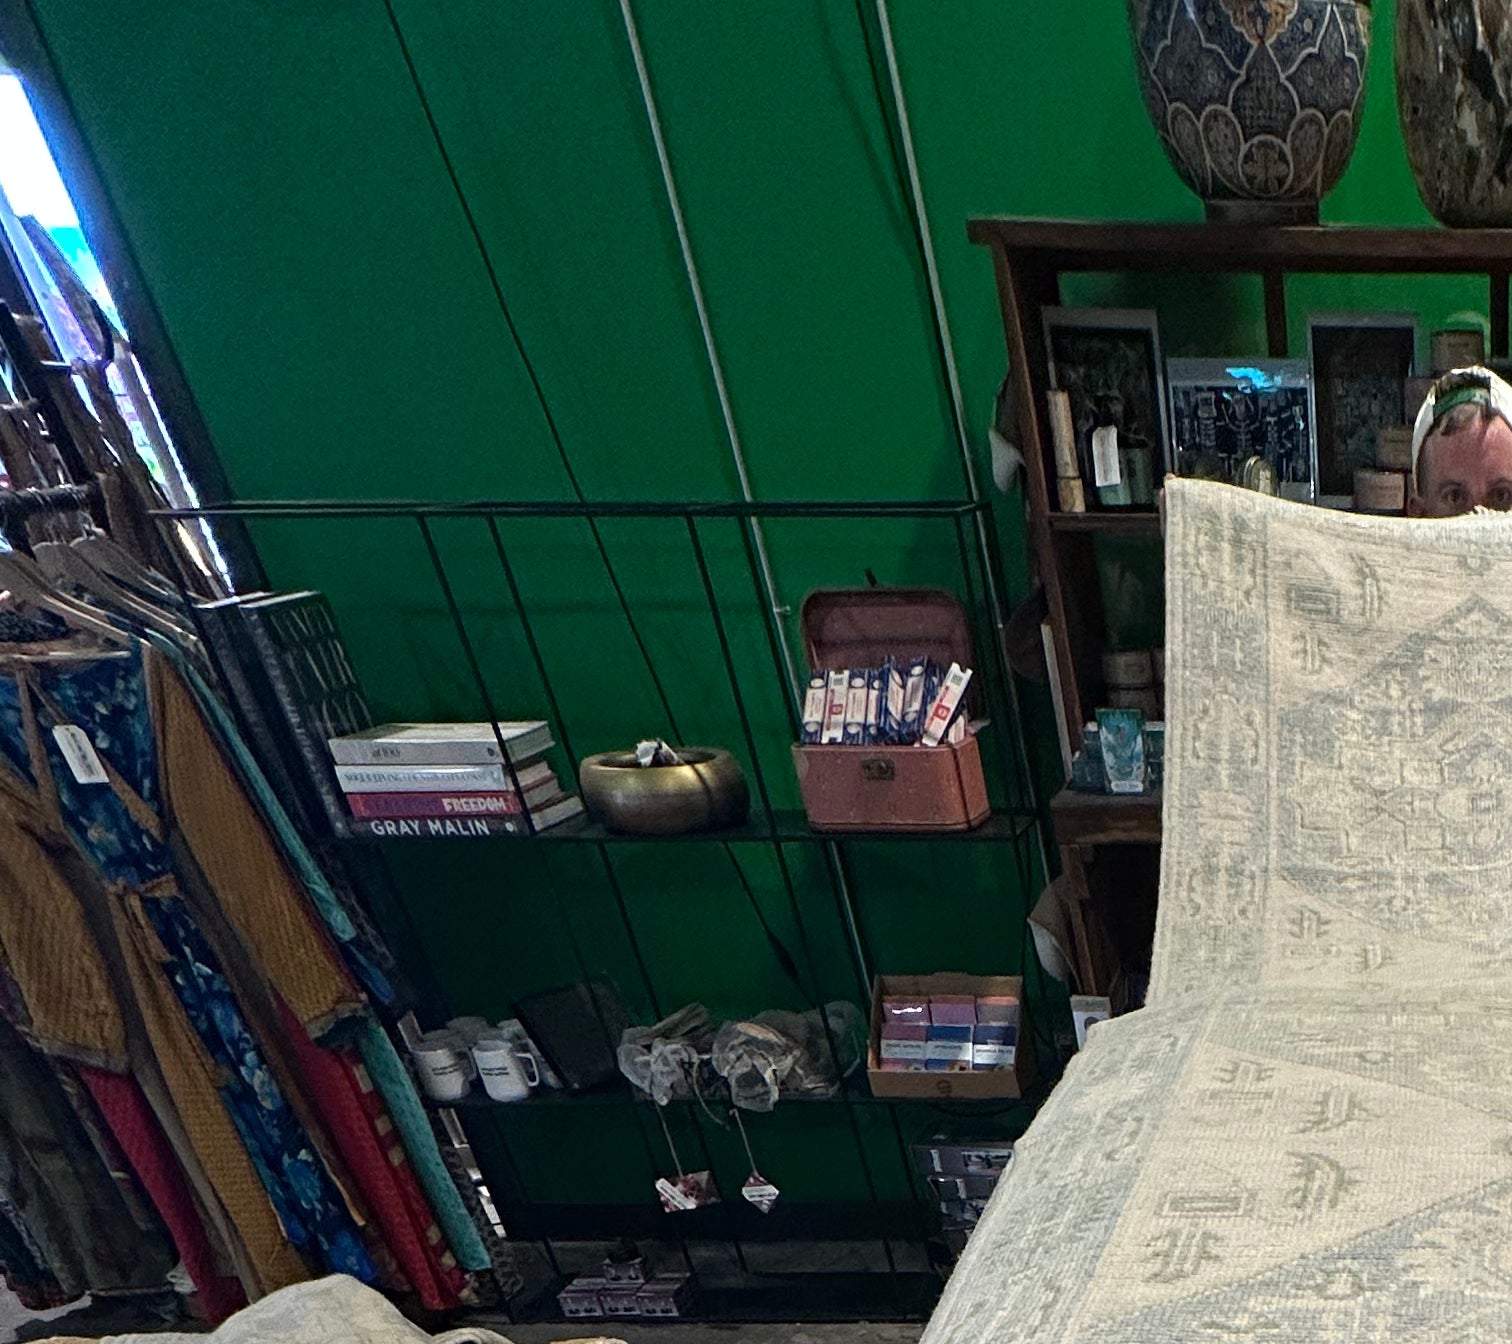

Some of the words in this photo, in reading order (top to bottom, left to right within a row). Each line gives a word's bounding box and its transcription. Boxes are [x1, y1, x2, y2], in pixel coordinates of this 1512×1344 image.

[442, 797, 506, 812] FREEDOM
[370, 820, 421, 836] GRAY
[427, 820, 491, 836] MALIN
